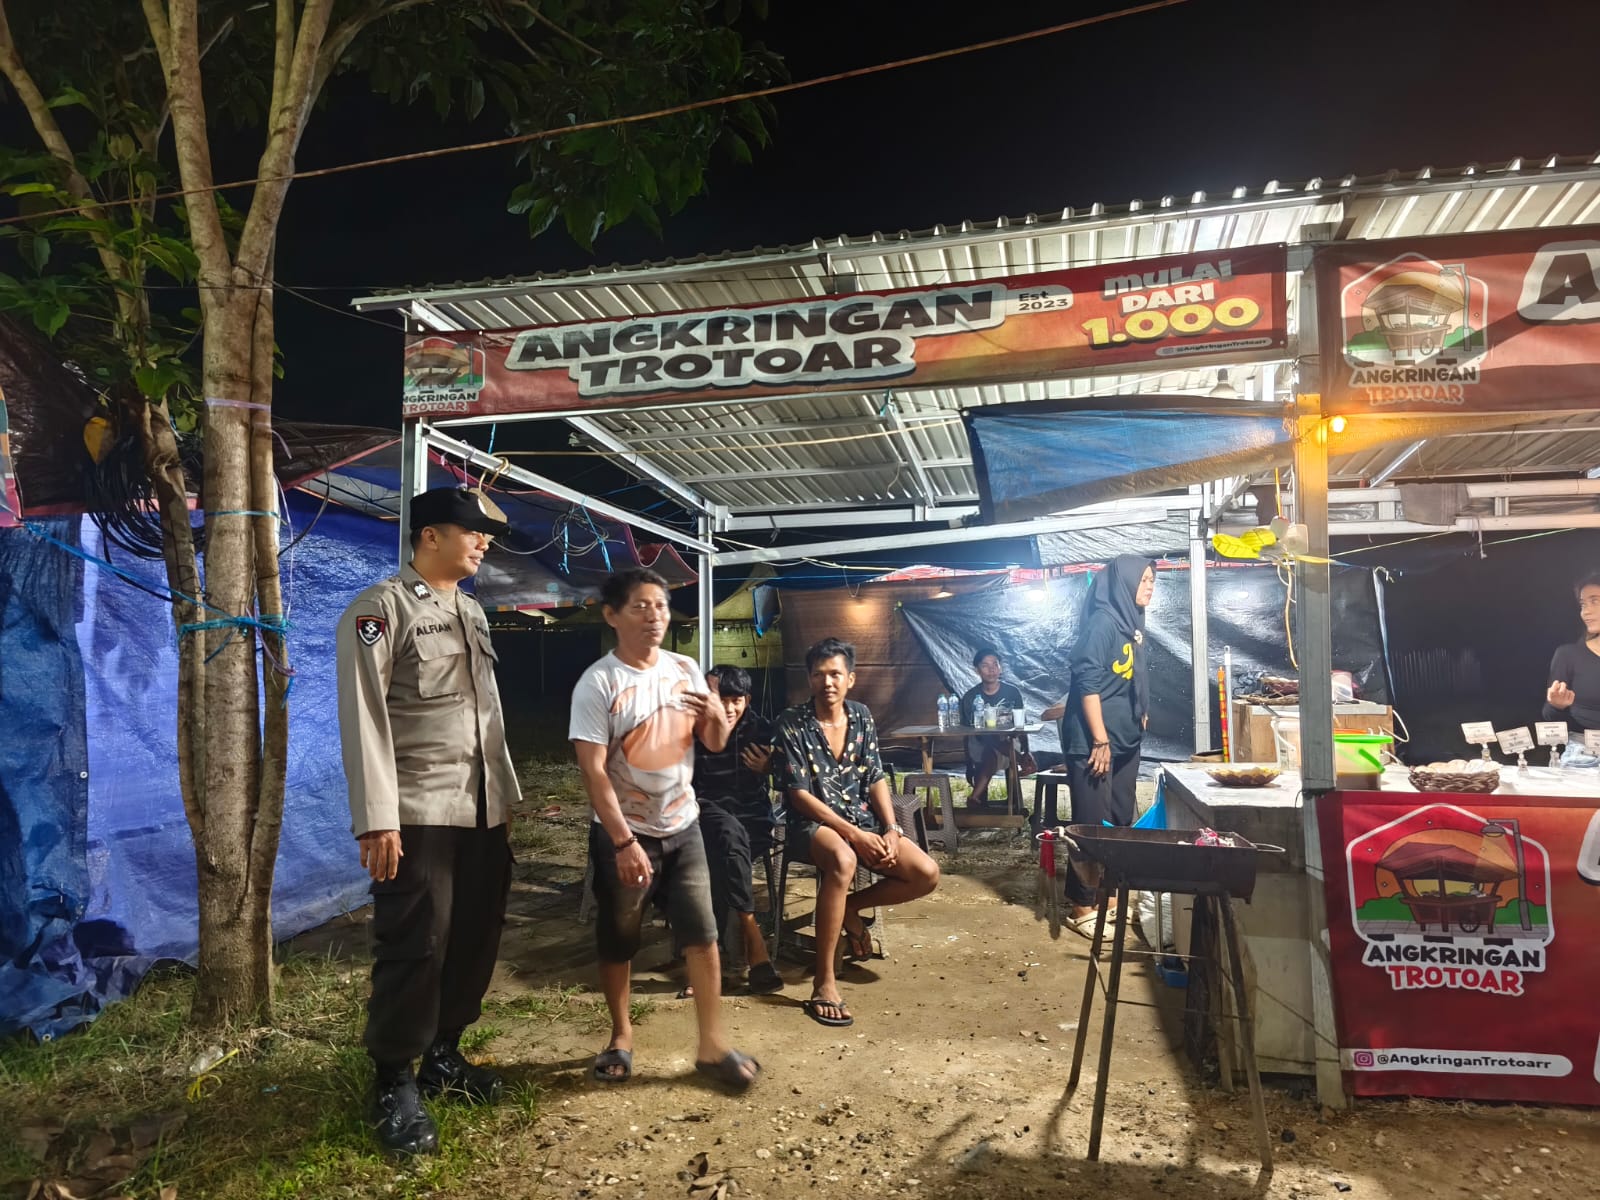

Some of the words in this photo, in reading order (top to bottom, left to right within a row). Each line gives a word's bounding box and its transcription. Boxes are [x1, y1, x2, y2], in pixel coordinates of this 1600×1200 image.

[1018, 290, 1049, 302] Est
[1018, 298, 1068, 311] 2023
[1122, 282, 1215, 313] DARI
[516, 291, 994, 363] ANGKRINGAN
[1082, 297, 1259, 345] 1.000
[578, 336, 902, 389] TROTOAR
[1353, 366, 1476, 384] ANGKRINGAN
[1367, 384, 1463, 404] TROTOAR
[1367, 944, 1540, 968] ANGKRINGAN
[1388, 965, 1520, 994] TROTOAR
[1377, 1052, 1552, 1069] @AngkringanTrotoarr
